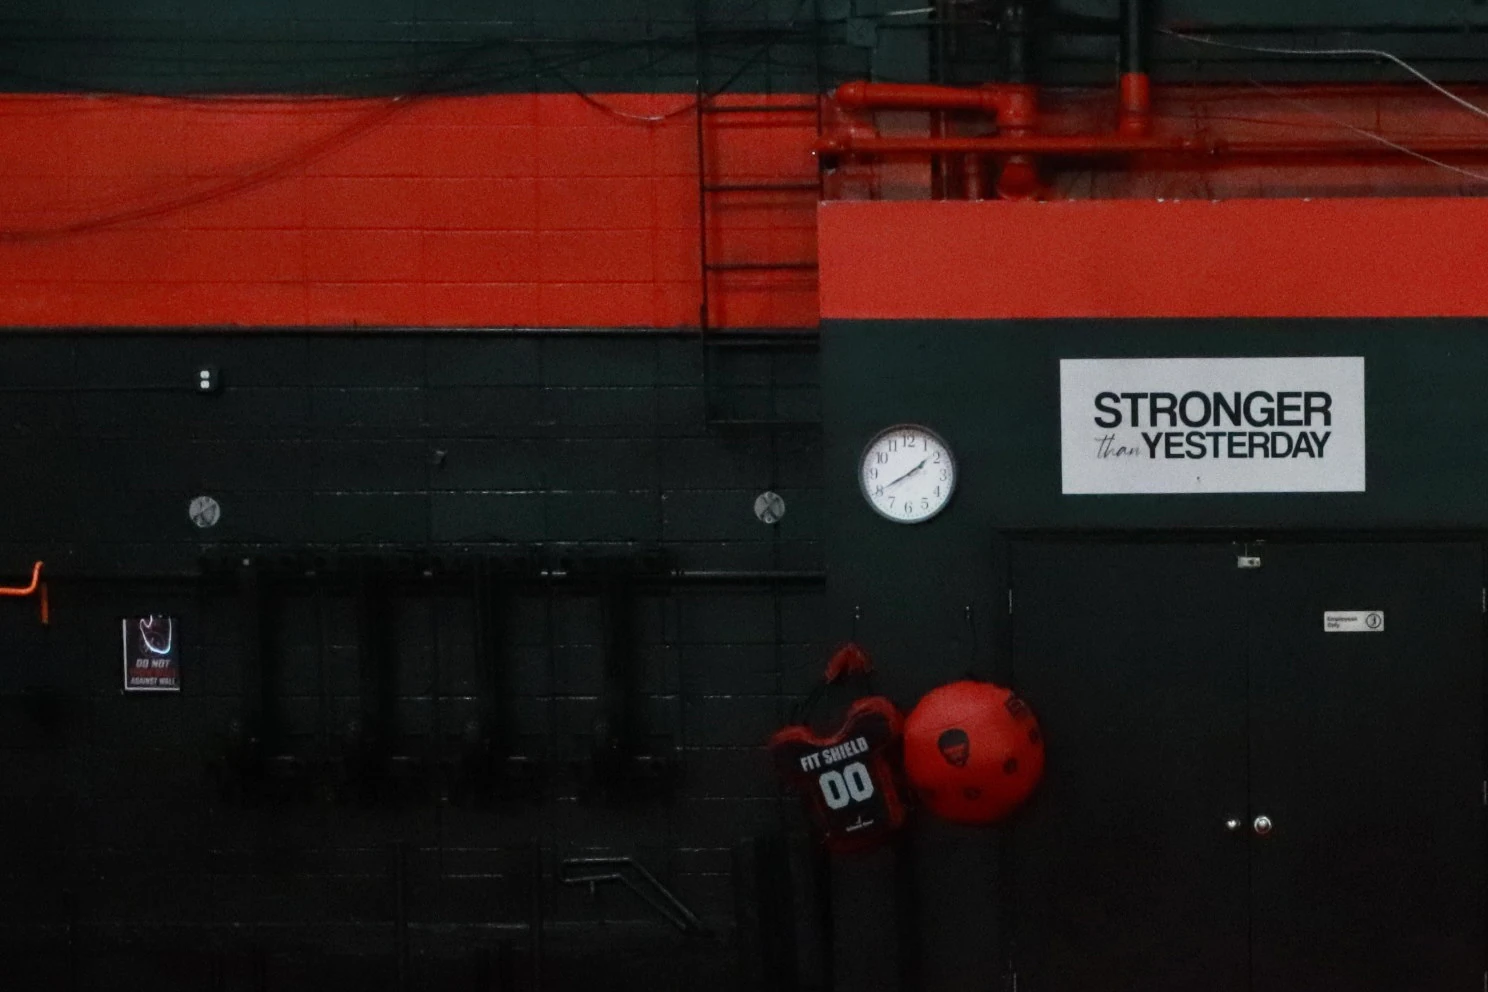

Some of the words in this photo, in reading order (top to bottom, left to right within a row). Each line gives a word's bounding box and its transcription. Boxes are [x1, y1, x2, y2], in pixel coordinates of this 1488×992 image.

[1094, 390, 1333, 429] STRONGER
[888, 440, 897, 452] 11
[903, 435, 915, 448] 12
[1094, 433, 1141, 459] than
[1141, 431, 1332, 460] YESTERDAY
[876, 452, 889, 465] 10
[932, 451, 941, 464] 2
[870, 468, 878, 481] 9
[939, 469, 947, 482] 3
[933, 485, 940, 498] 4
[888, 496, 896, 509] 7
[904, 501, 913, 514] 6
[921, 497, 929, 510] 5
[800, 752, 821, 772] FIT
[821, 736, 869, 765] SHIELD
[819, 761, 874, 810] 00
